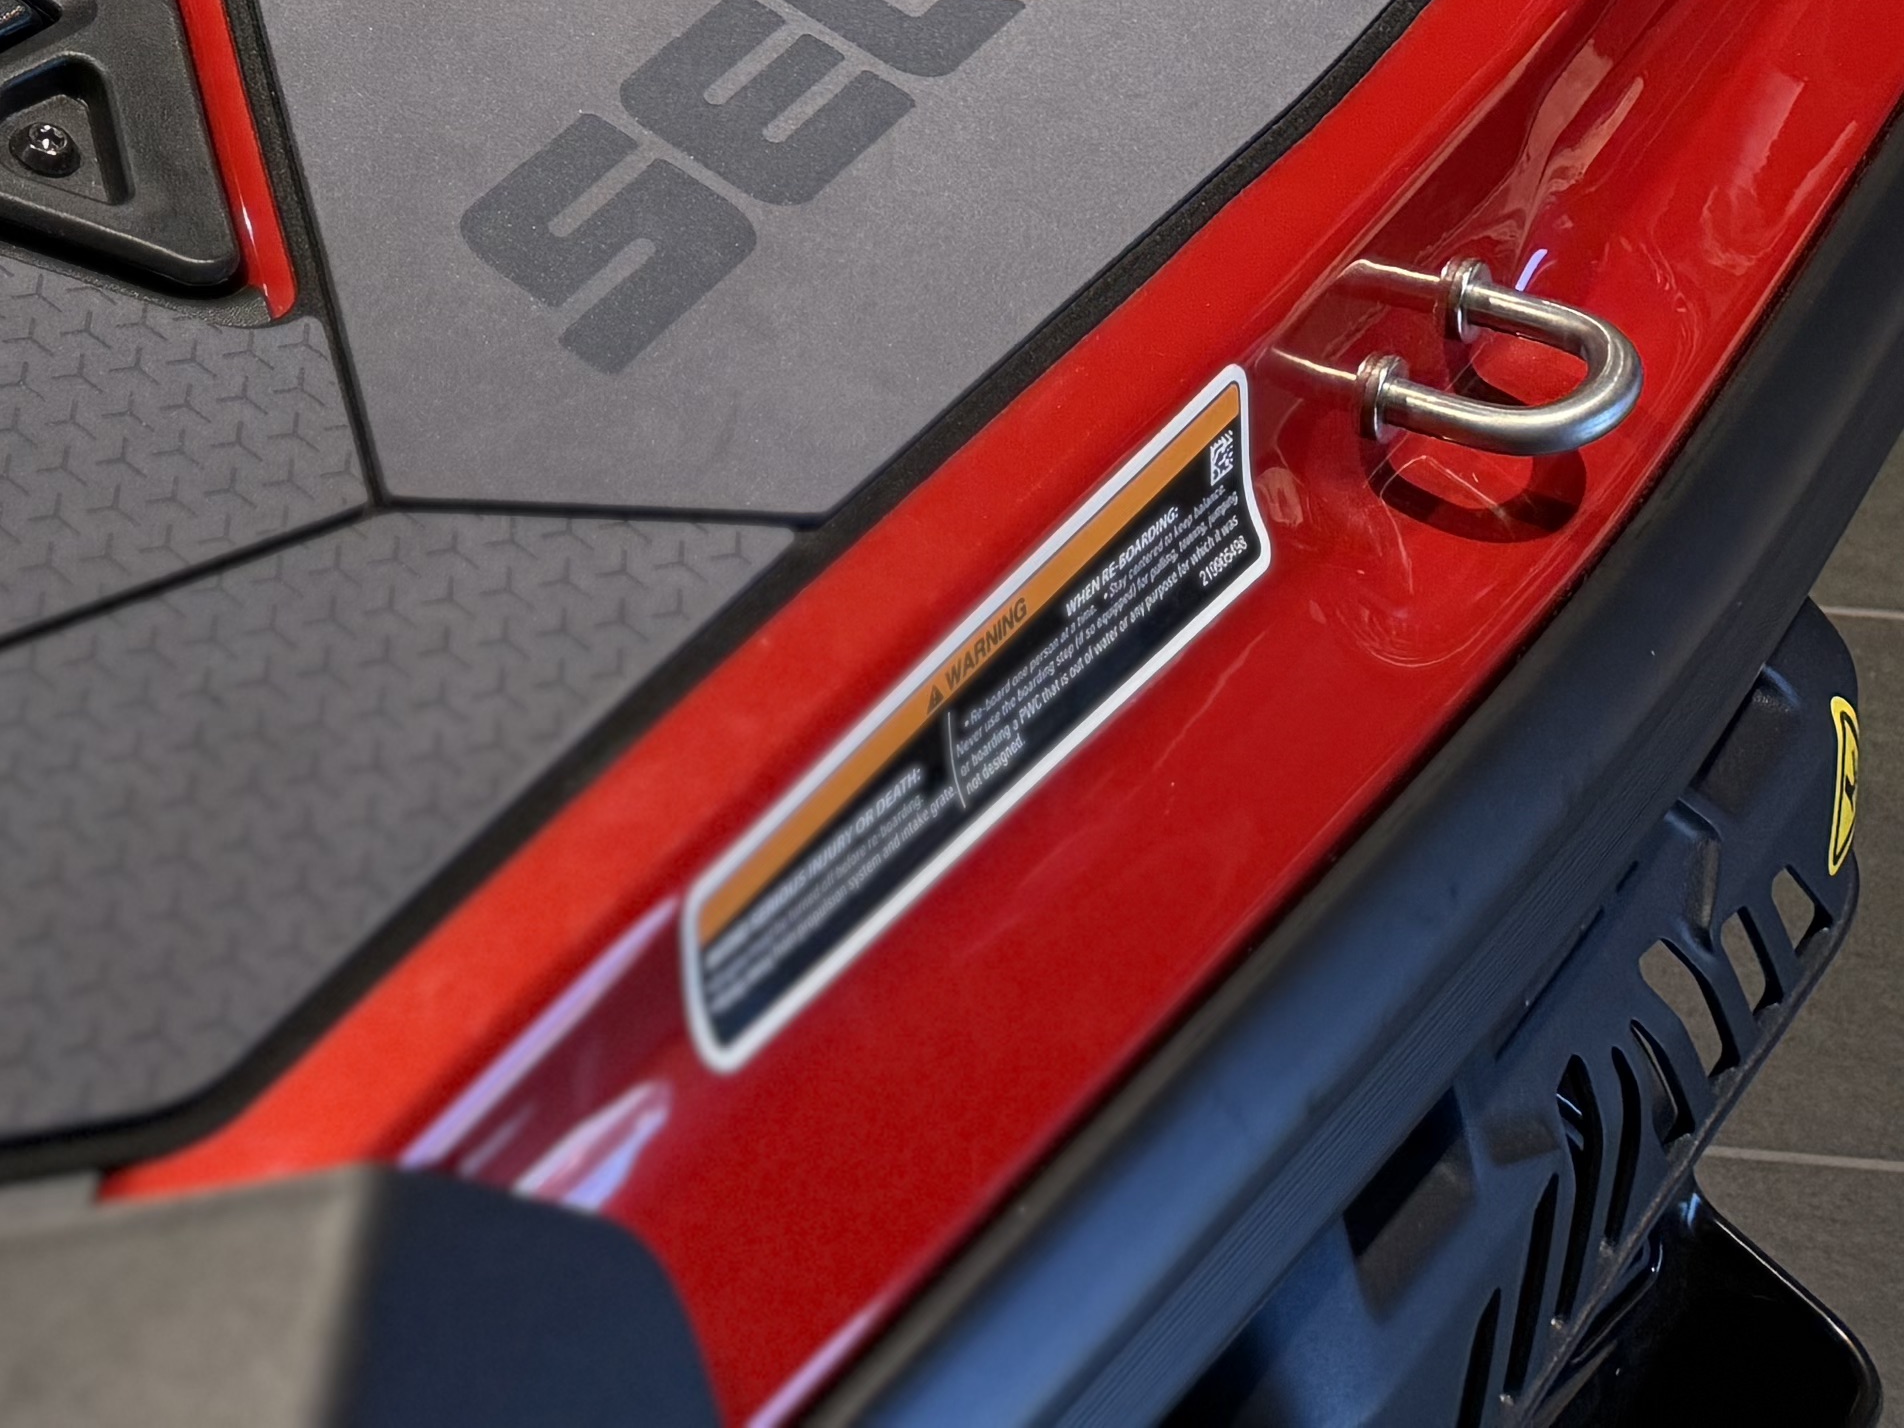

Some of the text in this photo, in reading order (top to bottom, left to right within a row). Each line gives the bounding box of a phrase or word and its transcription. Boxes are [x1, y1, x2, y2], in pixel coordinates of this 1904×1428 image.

[1065, 502, 1179, 618] WHEN RE-BOARDING:
[945, 597, 1027, 687] WARNING
[971, 721, 1011, 769] boarding
[1018, 692, 1042, 724] PWC
[1041, 677, 1060, 704] that
[1068, 655, 1083, 679] out
[1083, 644, 1094, 666] of
[1093, 624, 1118, 656] water
[1129, 599, 1145, 627] any
[1145, 569, 1178, 612] purpose
[1189, 532, 1214, 567] which
[1221, 512, 1238, 538] was
[1028, 636, 1059, 673] person
[955, 723, 983, 758] Never
[983, 709, 1001, 733] use
[1001, 694, 1016, 717] the
[1016, 658, 1055, 705] boarding
[1055, 640, 1074, 669] step
[965, 729, 1026, 796] not designed.
[807, 824, 854, 879] INJURY
[854, 807, 874, 835] OR
[875, 764, 922, 817] DEATH:
[847, 851, 881, 893] system
[881, 832, 900, 859] and
[900, 806, 929, 842] intake
